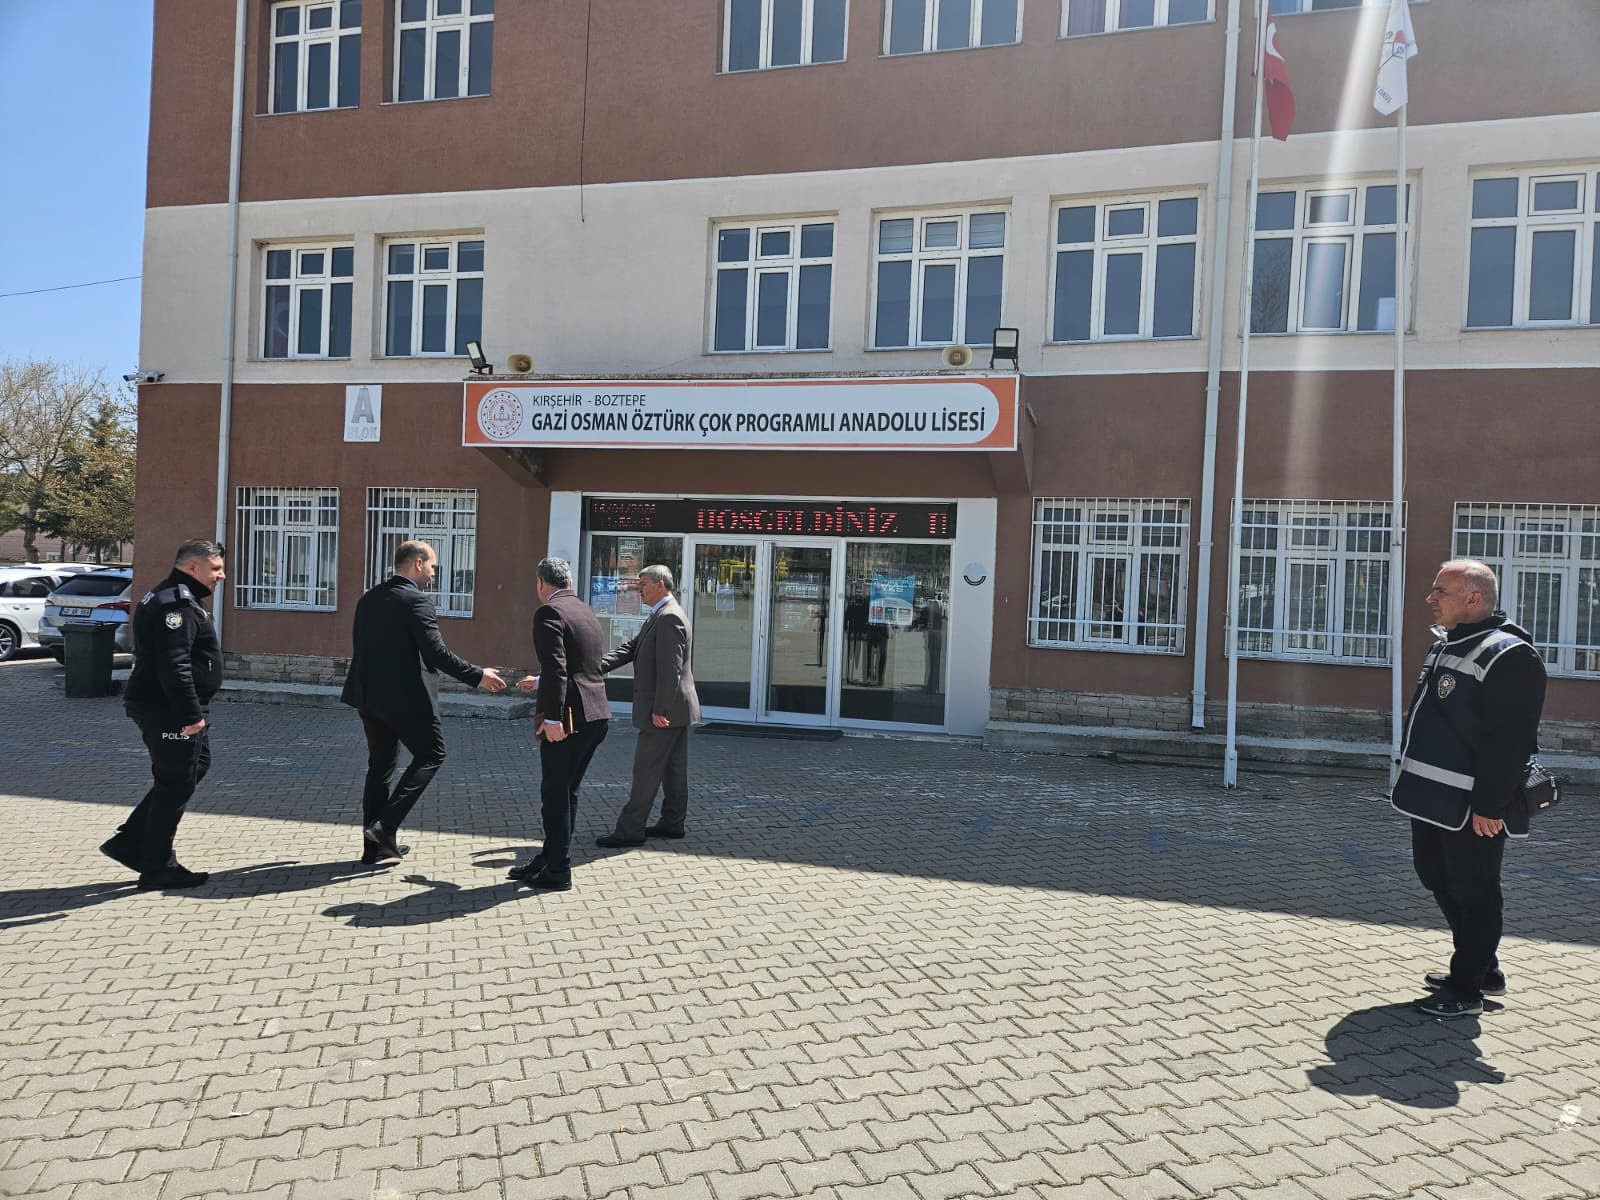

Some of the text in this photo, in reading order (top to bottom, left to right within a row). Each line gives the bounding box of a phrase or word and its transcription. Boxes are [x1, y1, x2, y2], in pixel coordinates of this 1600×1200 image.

[351, 388, 375, 423] A
[533, 393, 582, 409] KIRŞEHİR
[595, 394, 647, 407] BOZTEPE
[532, 409, 568, 431] GAZİ
[571, 412, 628, 431] OSMAN
[631, 409, 695, 432] ÖZTÜRK
[699, 413, 732, 437] ÇOK
[736, 412, 835, 432] PROGRAMLI
[839, 411, 927, 432] ANADOLU
[931, 407, 985, 432] LİSESİ
